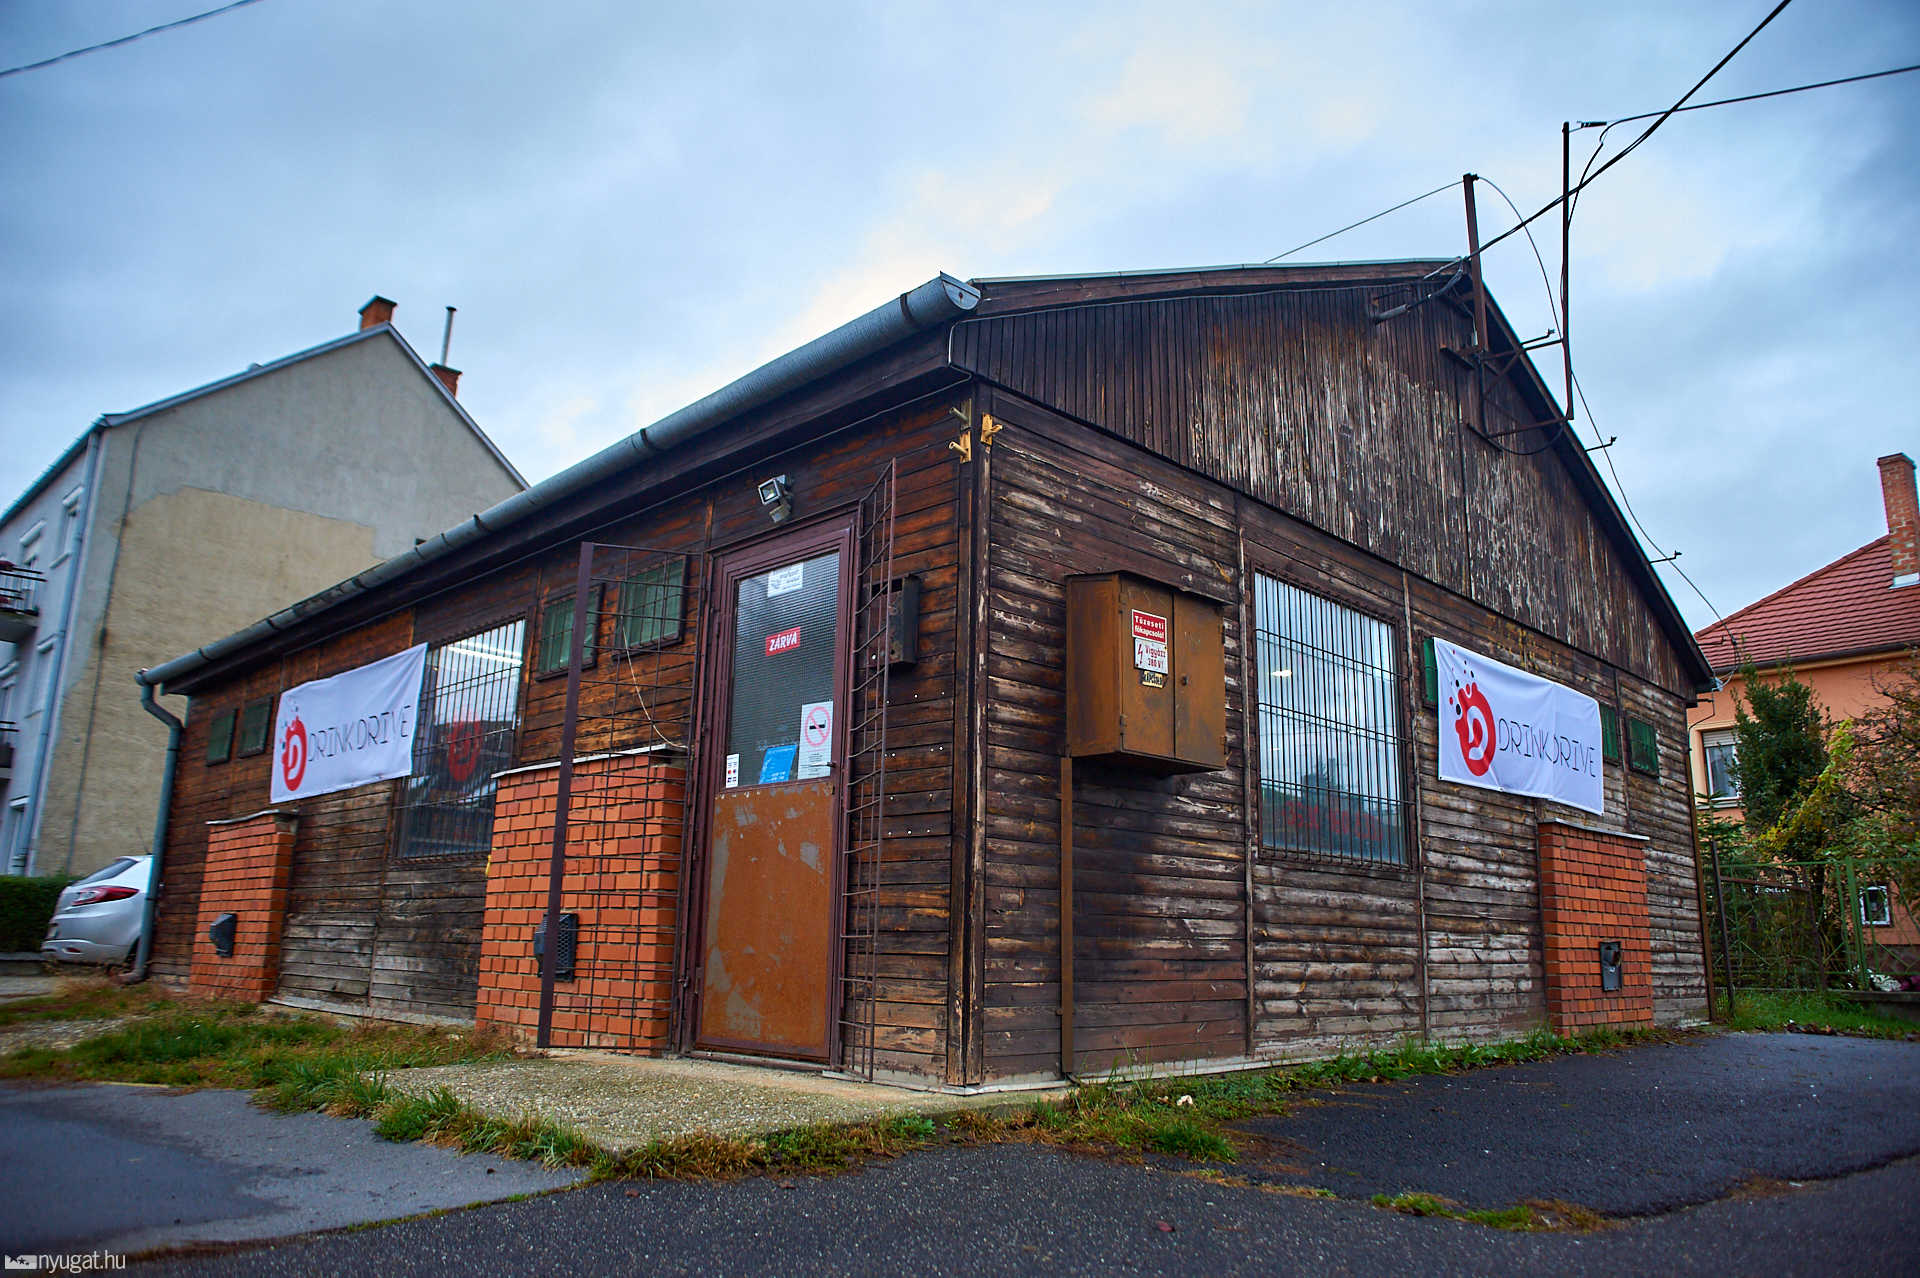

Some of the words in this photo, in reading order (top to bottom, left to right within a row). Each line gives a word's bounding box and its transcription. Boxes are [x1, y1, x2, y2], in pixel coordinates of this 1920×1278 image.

[769, 632, 797, 652] ZÁRVA
[308, 704, 412, 762] DRINKDRIVE
[1498, 718, 1597, 778] DRINKDRIVE
